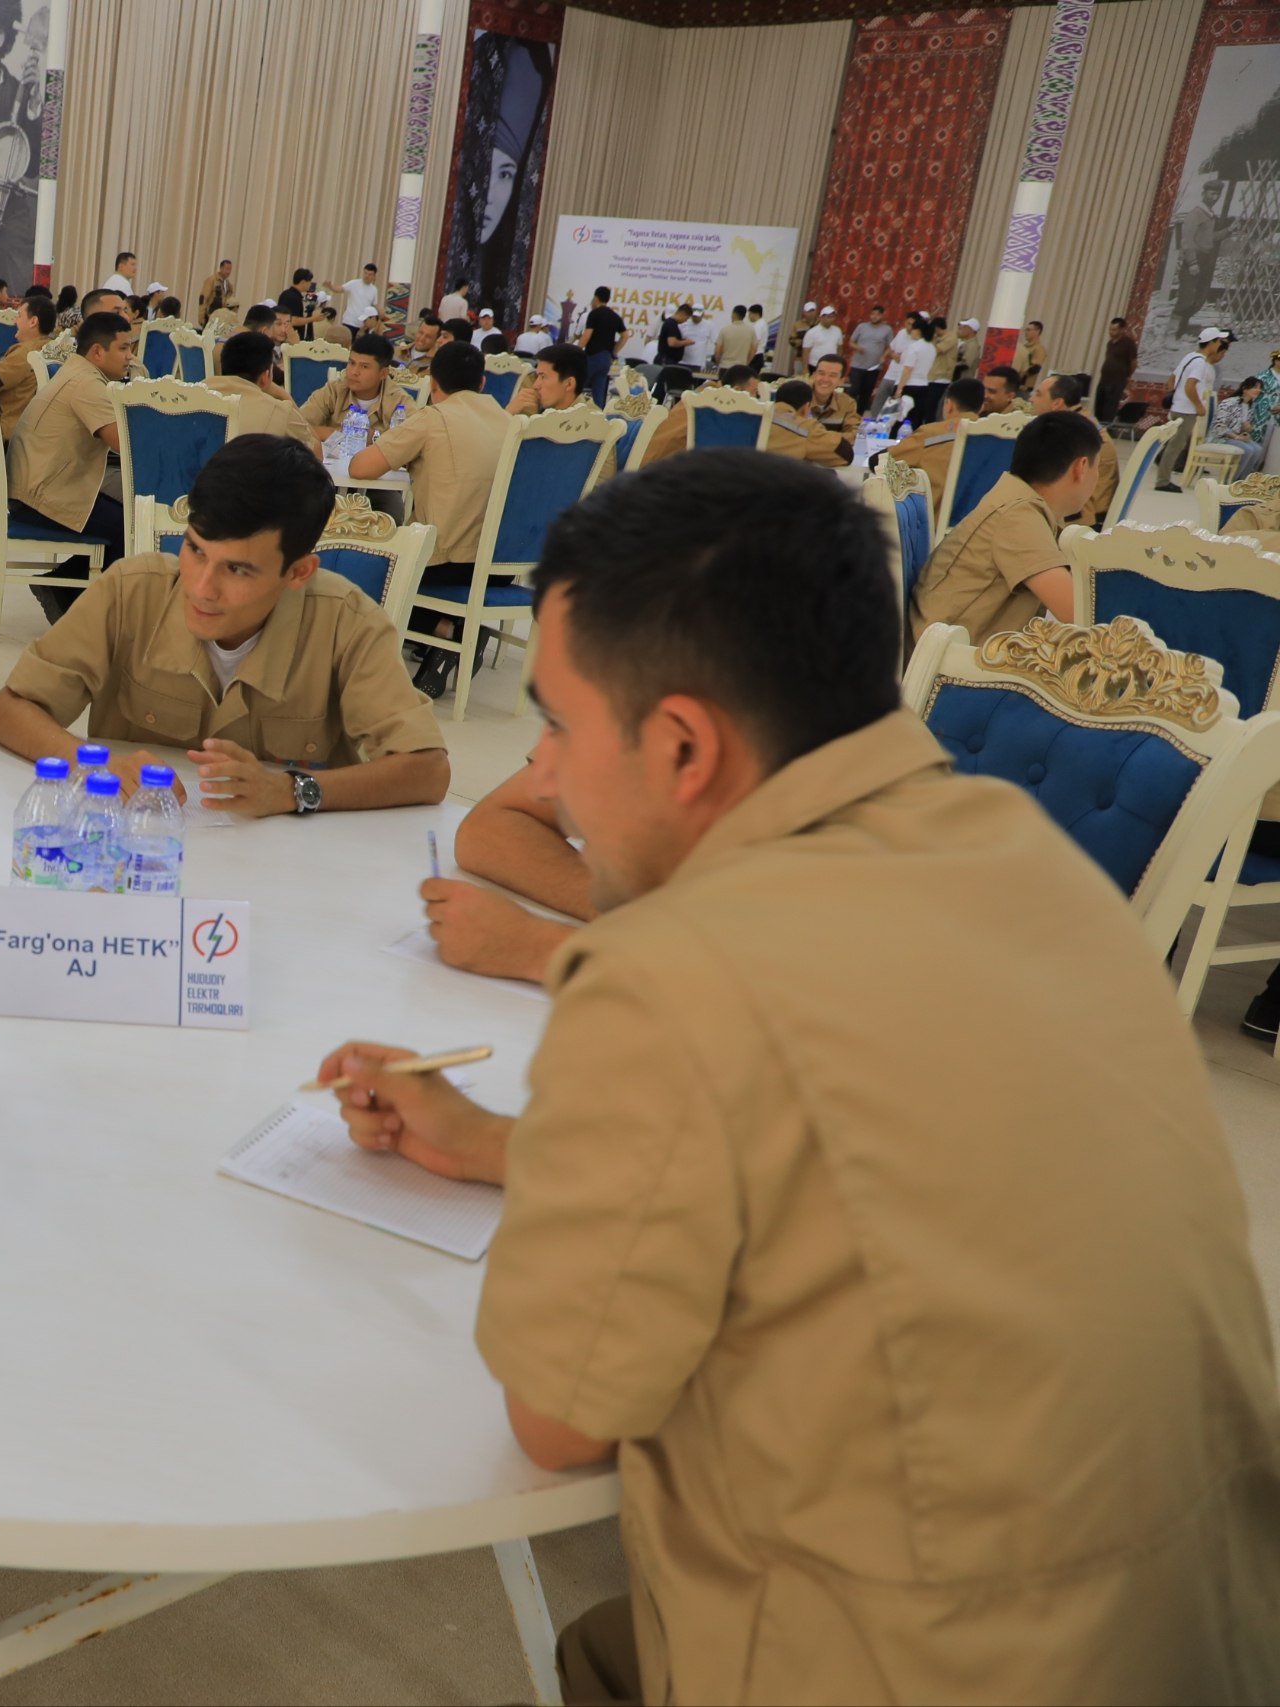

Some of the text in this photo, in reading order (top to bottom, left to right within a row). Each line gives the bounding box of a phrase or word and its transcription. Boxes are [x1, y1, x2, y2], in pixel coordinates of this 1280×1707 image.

[701, 293, 725, 312] VA
[67, 958, 98, 978] AJ
[187, 972, 226, 986] HUDUDIY
[187, 987, 220, 1001] ELEKTR
[187, 1002, 244, 1017] TARMOQLARI
